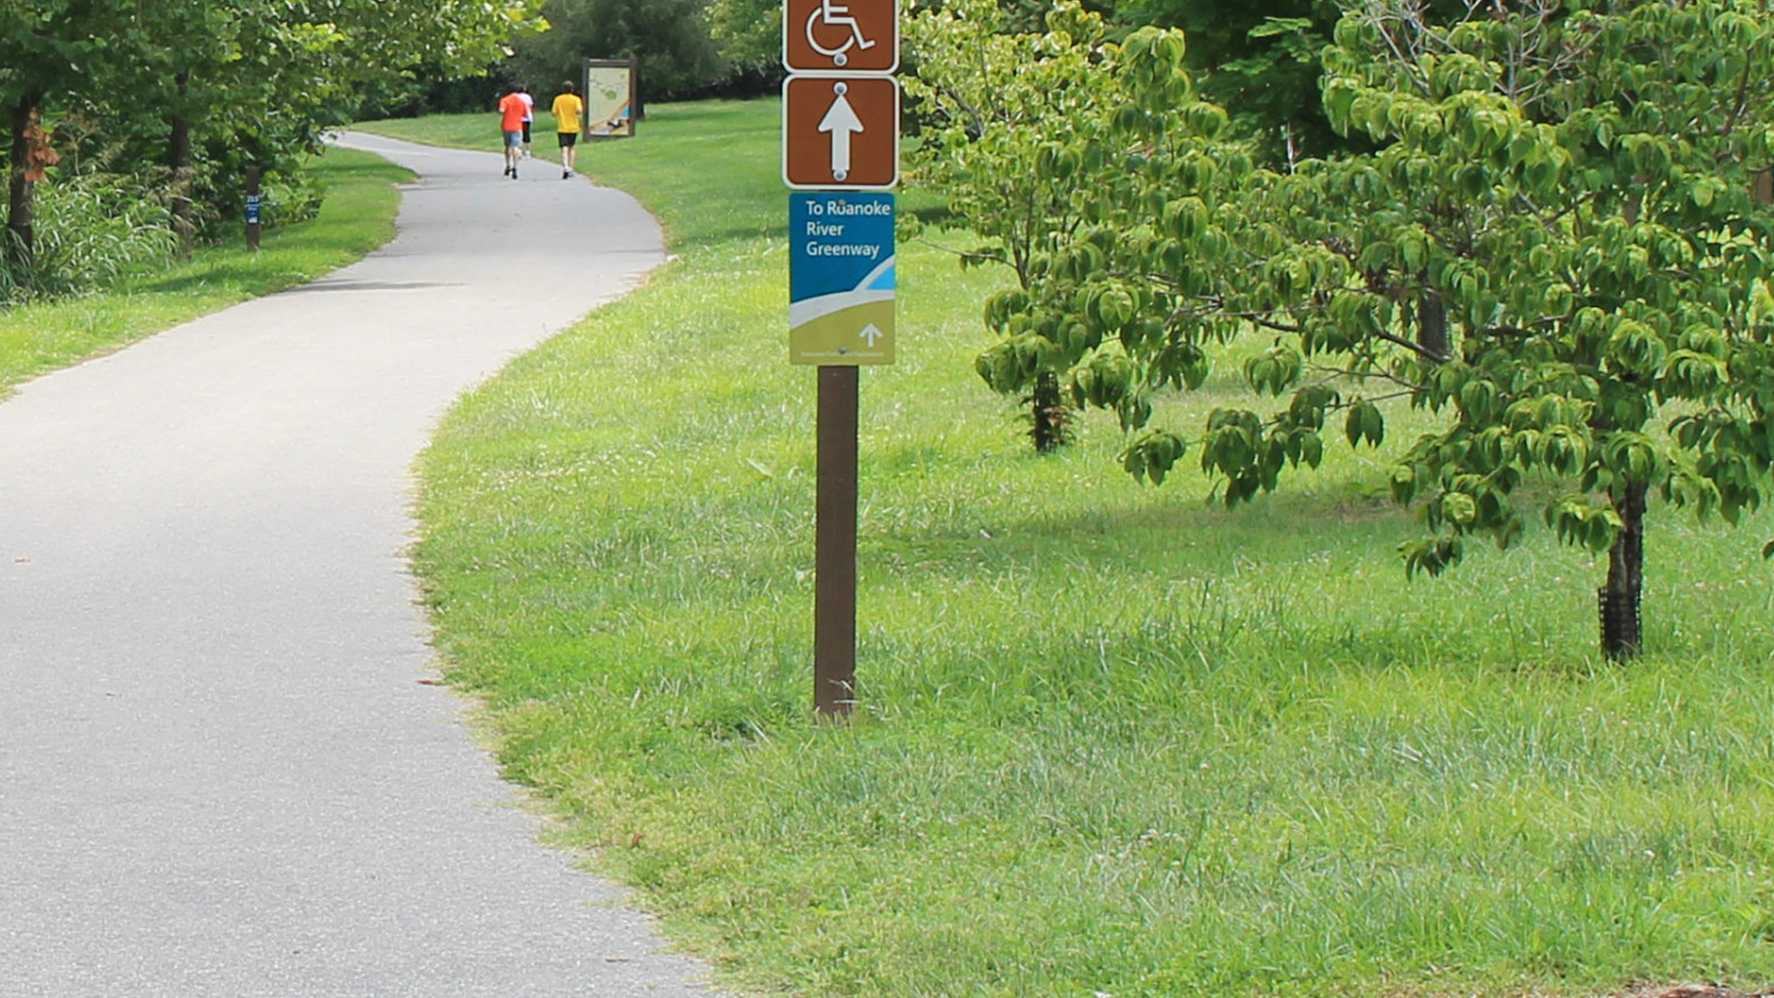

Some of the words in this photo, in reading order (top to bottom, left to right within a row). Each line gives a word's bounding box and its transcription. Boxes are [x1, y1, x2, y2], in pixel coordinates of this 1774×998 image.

[805, 200, 824, 215] To
[827, 199, 891, 216] Roanoke
[806, 221, 844, 236] River
[805, 241, 880, 260] Greenway
